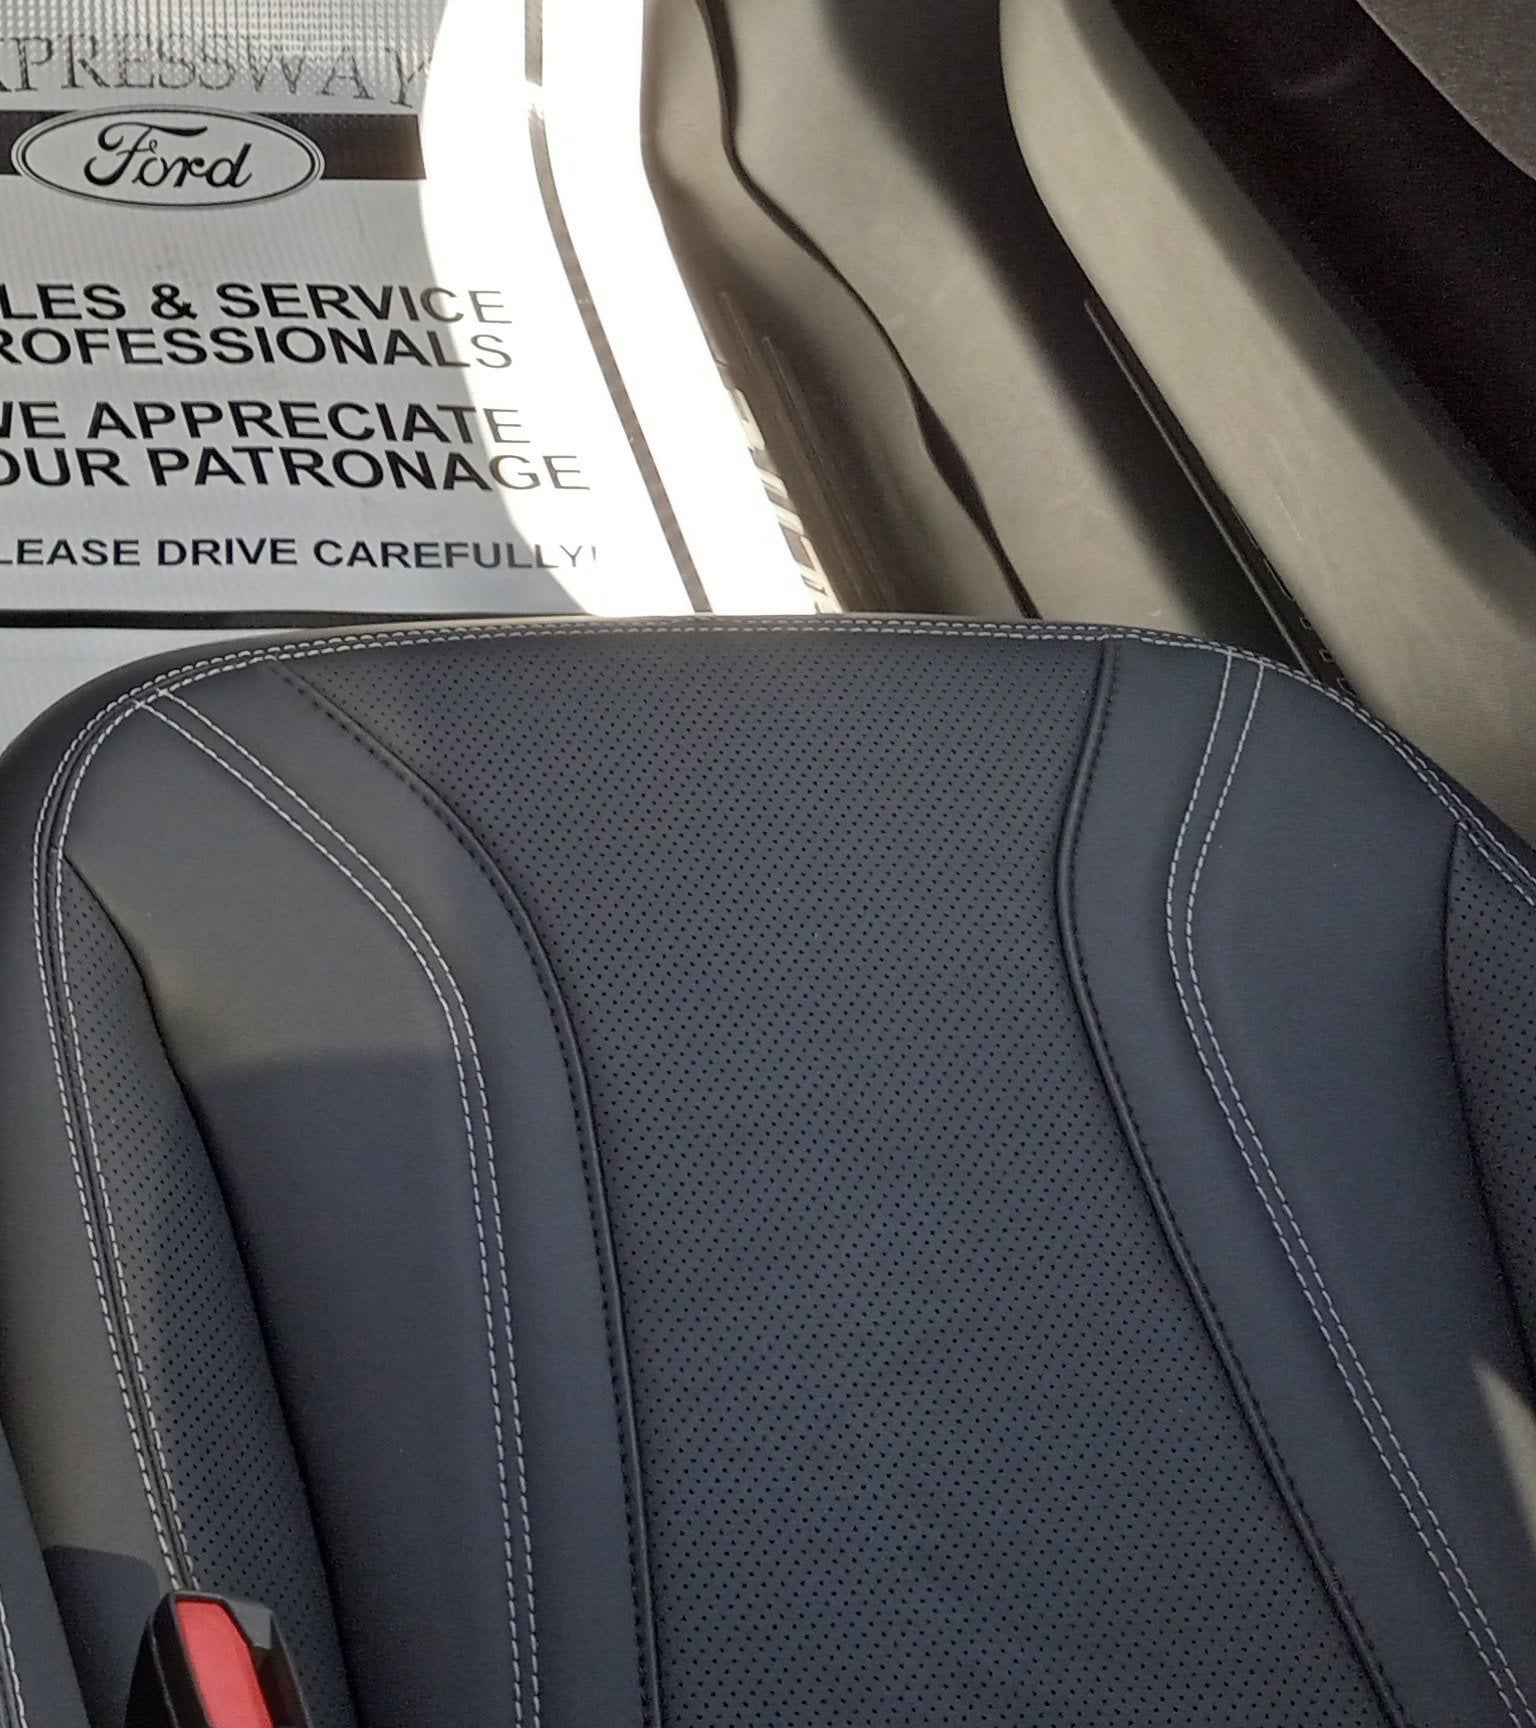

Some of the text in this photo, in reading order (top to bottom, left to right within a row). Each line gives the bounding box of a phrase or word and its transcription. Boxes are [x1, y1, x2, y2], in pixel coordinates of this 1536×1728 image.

[84, 122, 253, 189] Ford
[149, 282, 199, 321] &
[218, 282, 513, 325] SERVICE
[86, 399, 531, 445] APPRECIATE
[150, 446, 592, 492] PATRONAGE
[158, 537, 298, 567] DRIVE
[313, 538, 599, 571] CAREFULLY!
